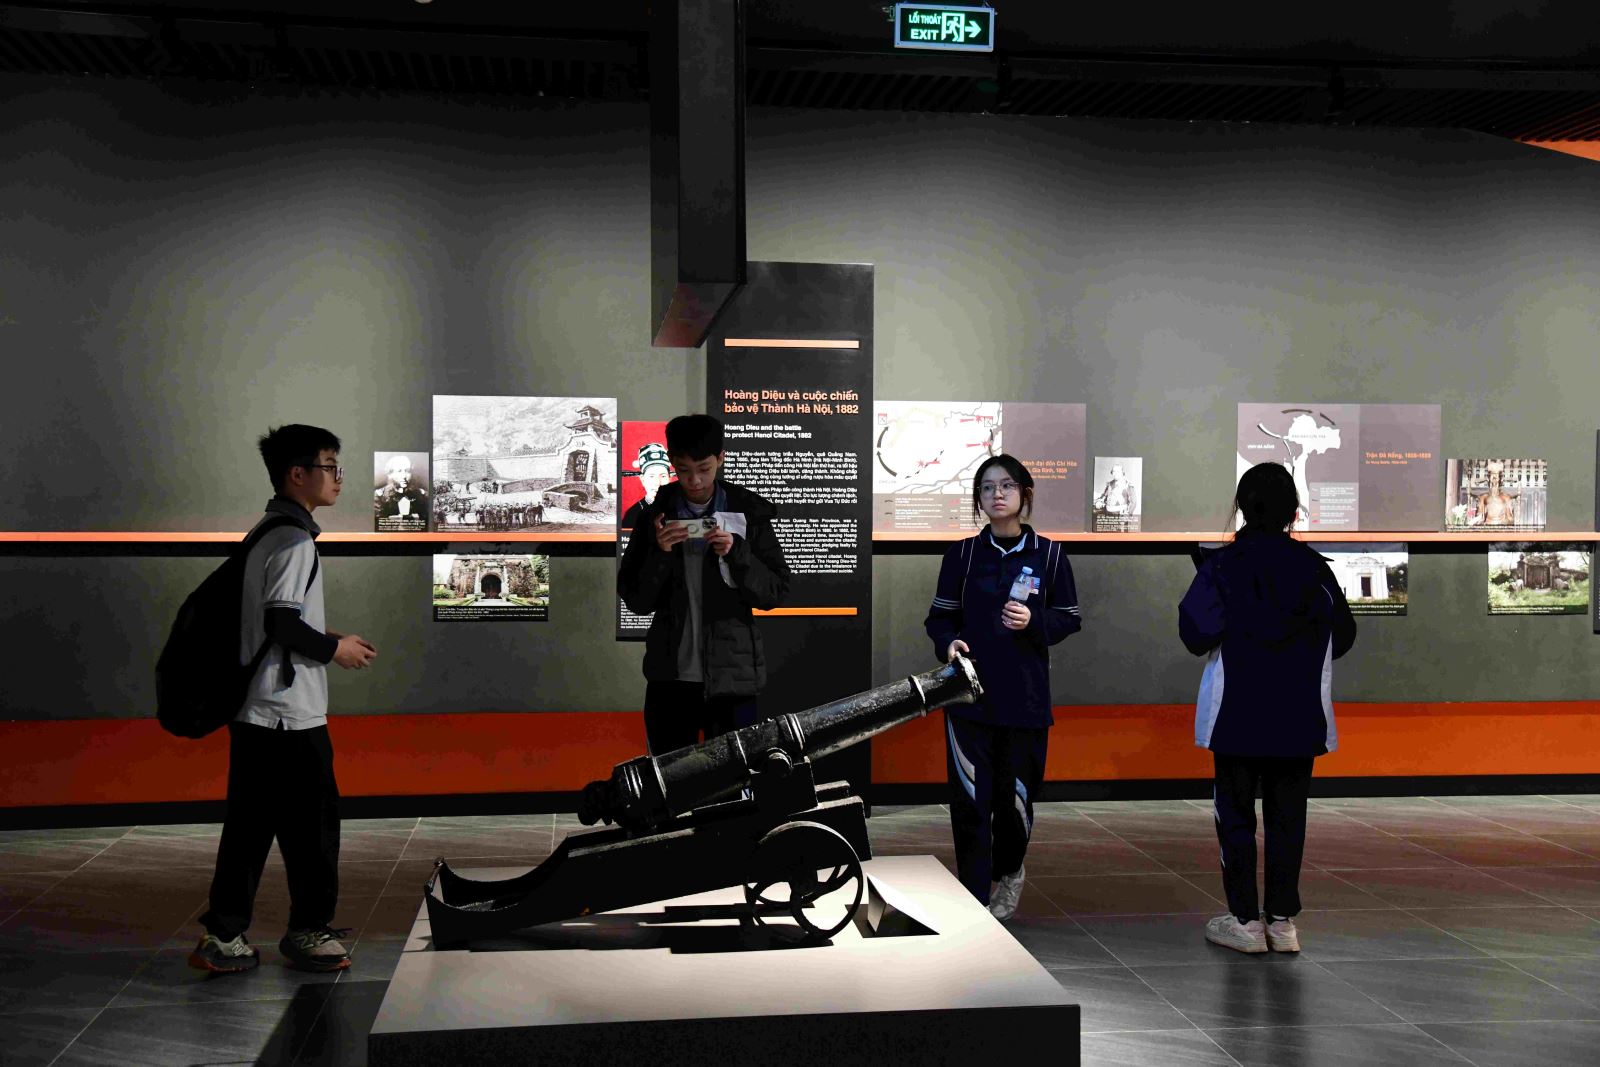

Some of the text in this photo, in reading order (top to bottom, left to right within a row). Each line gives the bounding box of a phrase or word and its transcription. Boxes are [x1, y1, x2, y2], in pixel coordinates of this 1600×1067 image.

[910, 28, 939, 41] EXIT
[725, 389, 858, 402] Hoàng Diệu và cuộc chiến
[724, 402, 859, 415] bảo vệ Thành Hà Nội, 1882
[724, 424, 745, 432] Hoang
